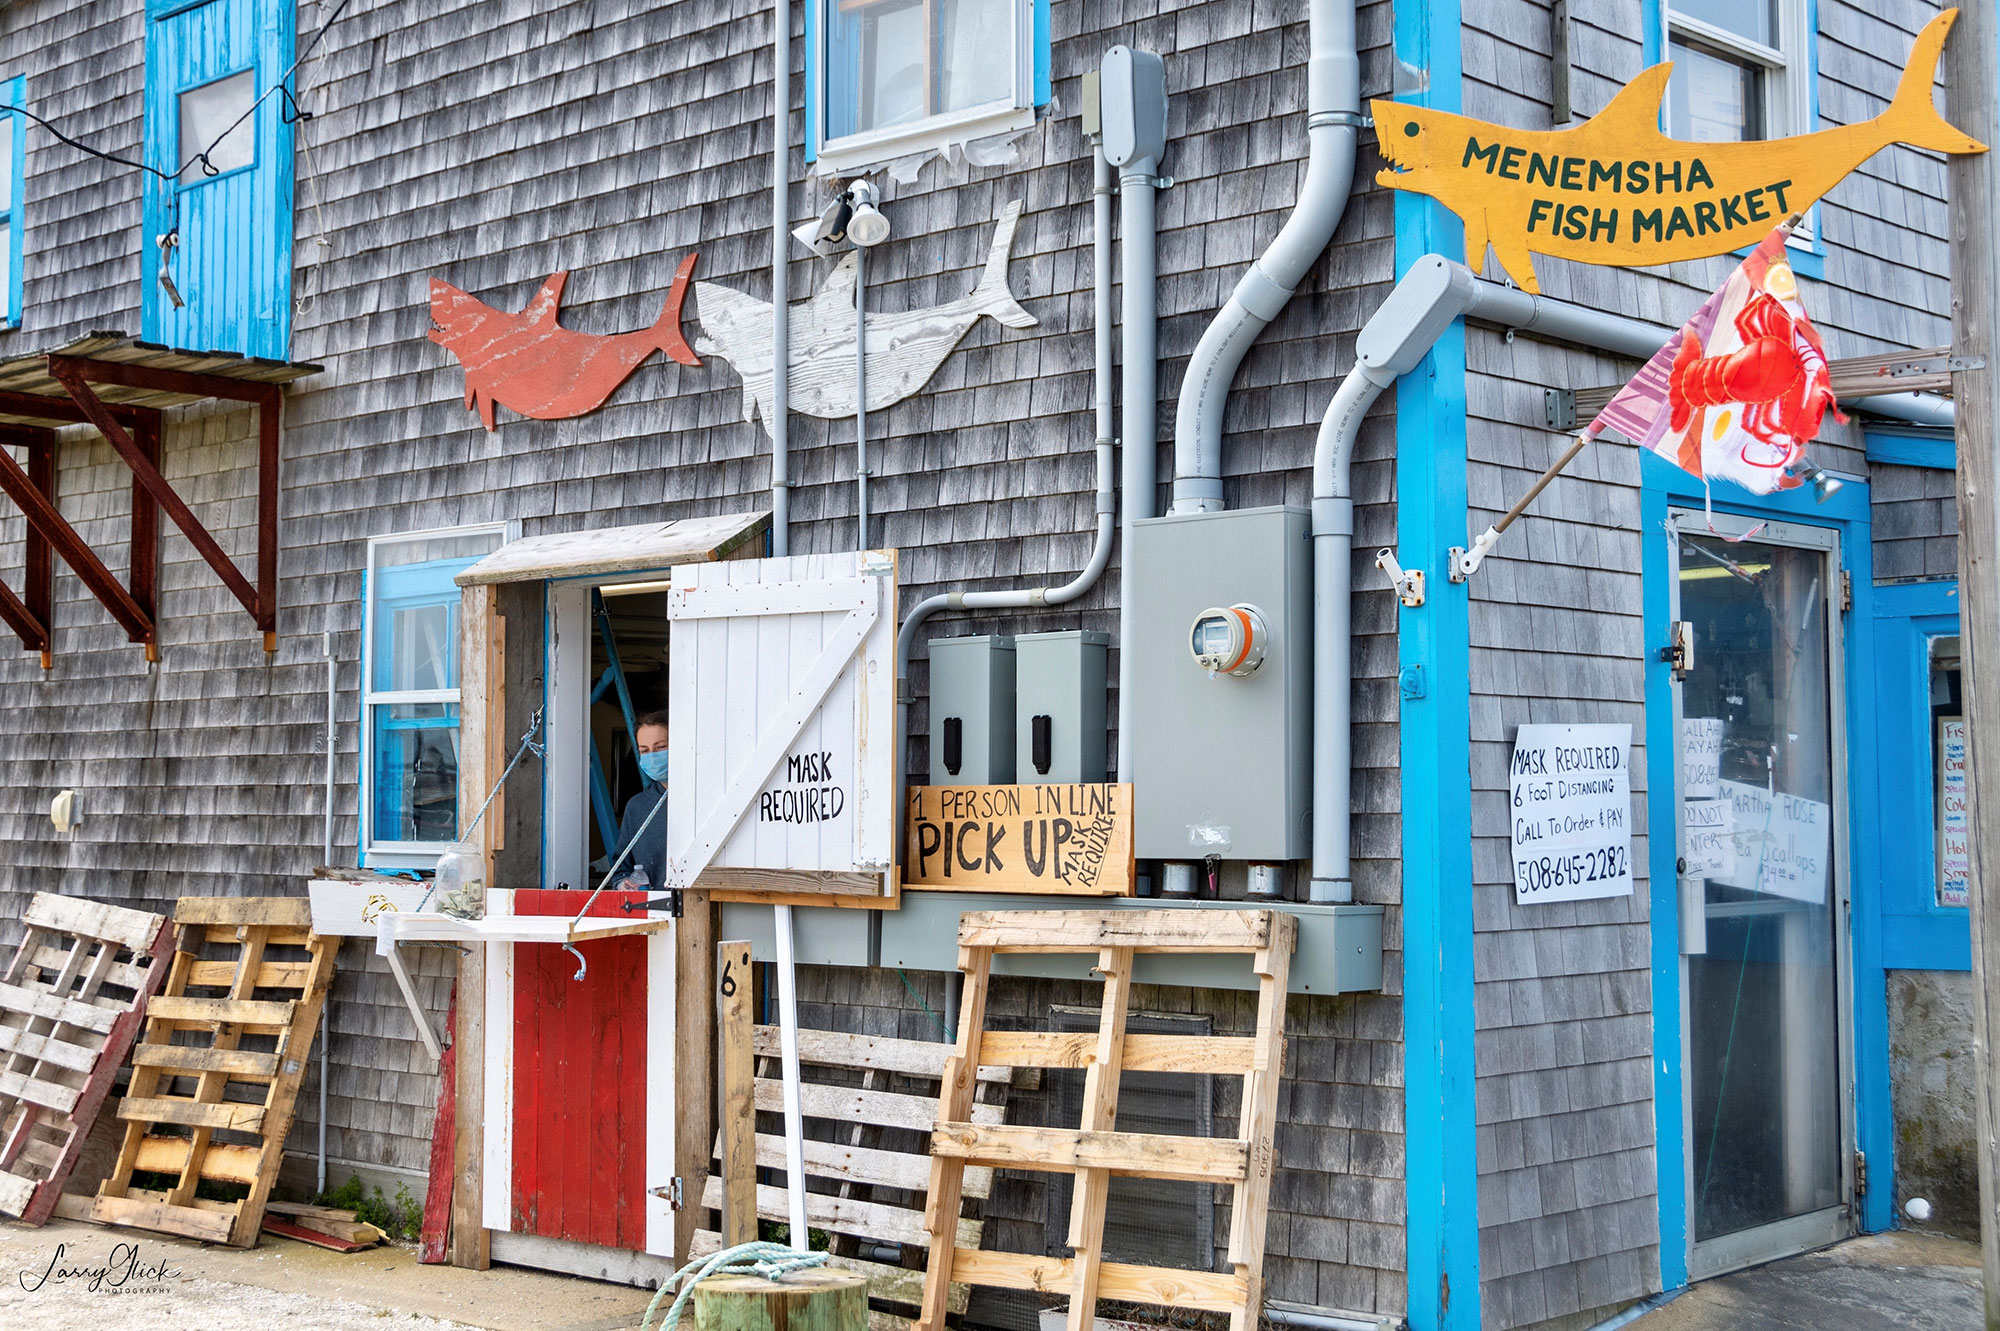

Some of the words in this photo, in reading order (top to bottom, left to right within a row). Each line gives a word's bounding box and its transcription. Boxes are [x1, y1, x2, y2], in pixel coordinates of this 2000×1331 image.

[1461, 136, 1715, 194] MENEMSHA
[1527, 199, 1619, 243] FISH
[1632, 180, 1793, 243] MARKET
[1683, 721, 1704, 737] ALL
[1945, 724, 1964, 739] Fis
[1683, 740, 1704, 754] AY
[788, 751, 833, 783] MASK
[1513, 749, 1548, 776] MASK
[1945, 758, 1965, 771] Cra
[911, 790, 928, 821] 1
[941, 787, 1021, 820] PERSON
[1035, 785, 1061, 815] IN
[1069, 783, 1118, 816] LINE
[1514, 783, 1523, 807] 6
[1558, 778, 1614, 799] DISTANCING
[1698, 804, 1724, 825] NOT
[1783, 795, 1817, 825] ROSE
[1516, 818, 1543, 845] CALL
[1564, 814, 1594, 833] Order
[1606, 807, 1623, 830] PAY
[917, 820, 1007, 878] PICK
[1023, 817, 1073, 879] UP
[1061, 820, 1092, 886] MASK
[1944, 868, 1968, 881] Smo
